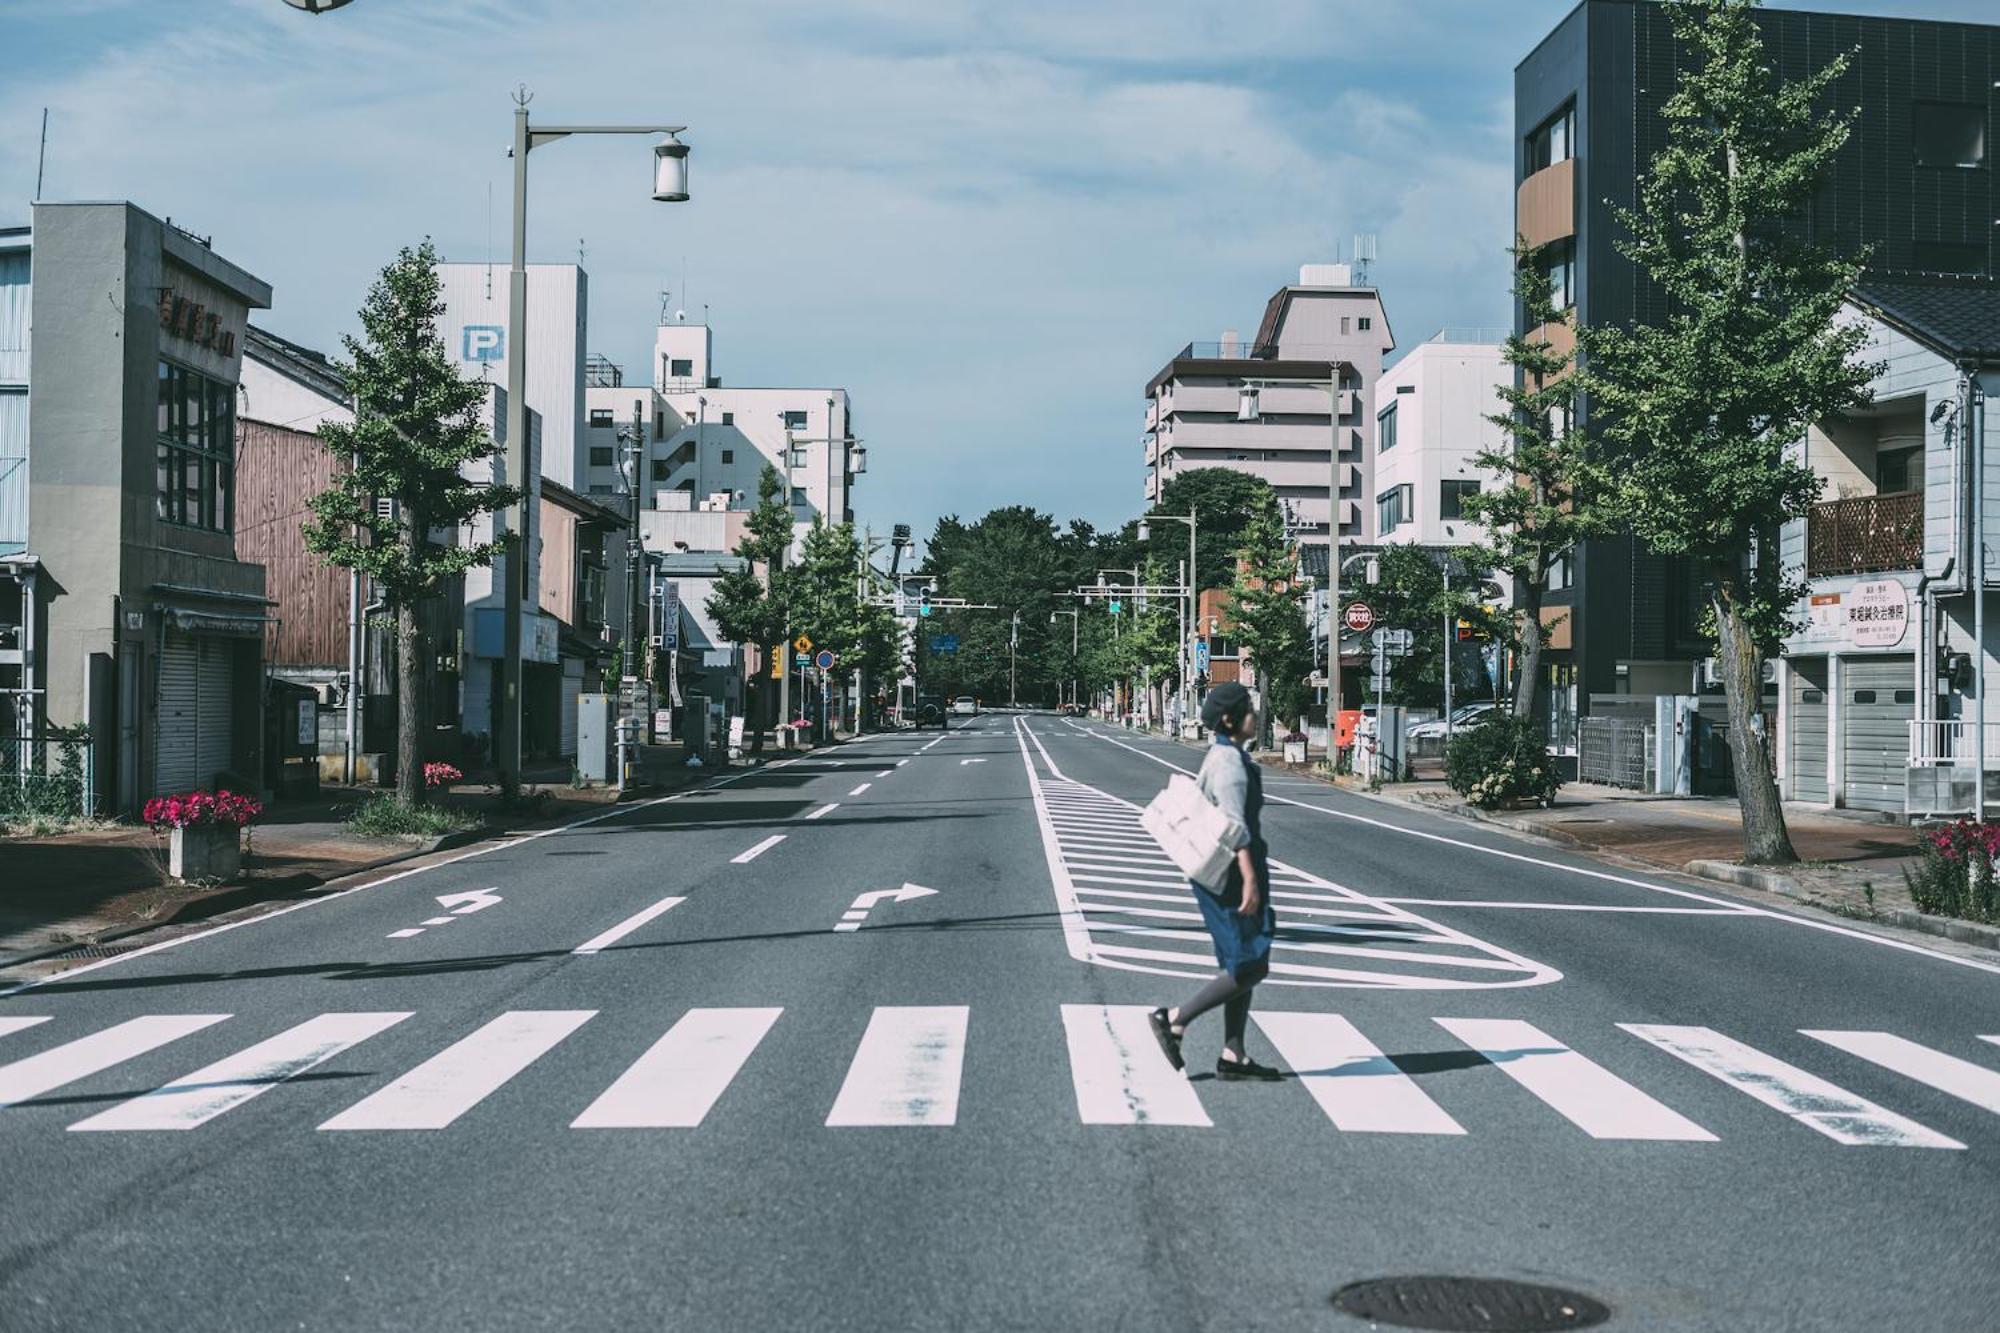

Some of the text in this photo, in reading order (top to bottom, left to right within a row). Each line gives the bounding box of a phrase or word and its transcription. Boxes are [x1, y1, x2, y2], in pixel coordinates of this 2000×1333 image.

[469, 329, 498, 358] P
[666, 635, 676, 648] P
[1459, 629, 1472, 641] P
